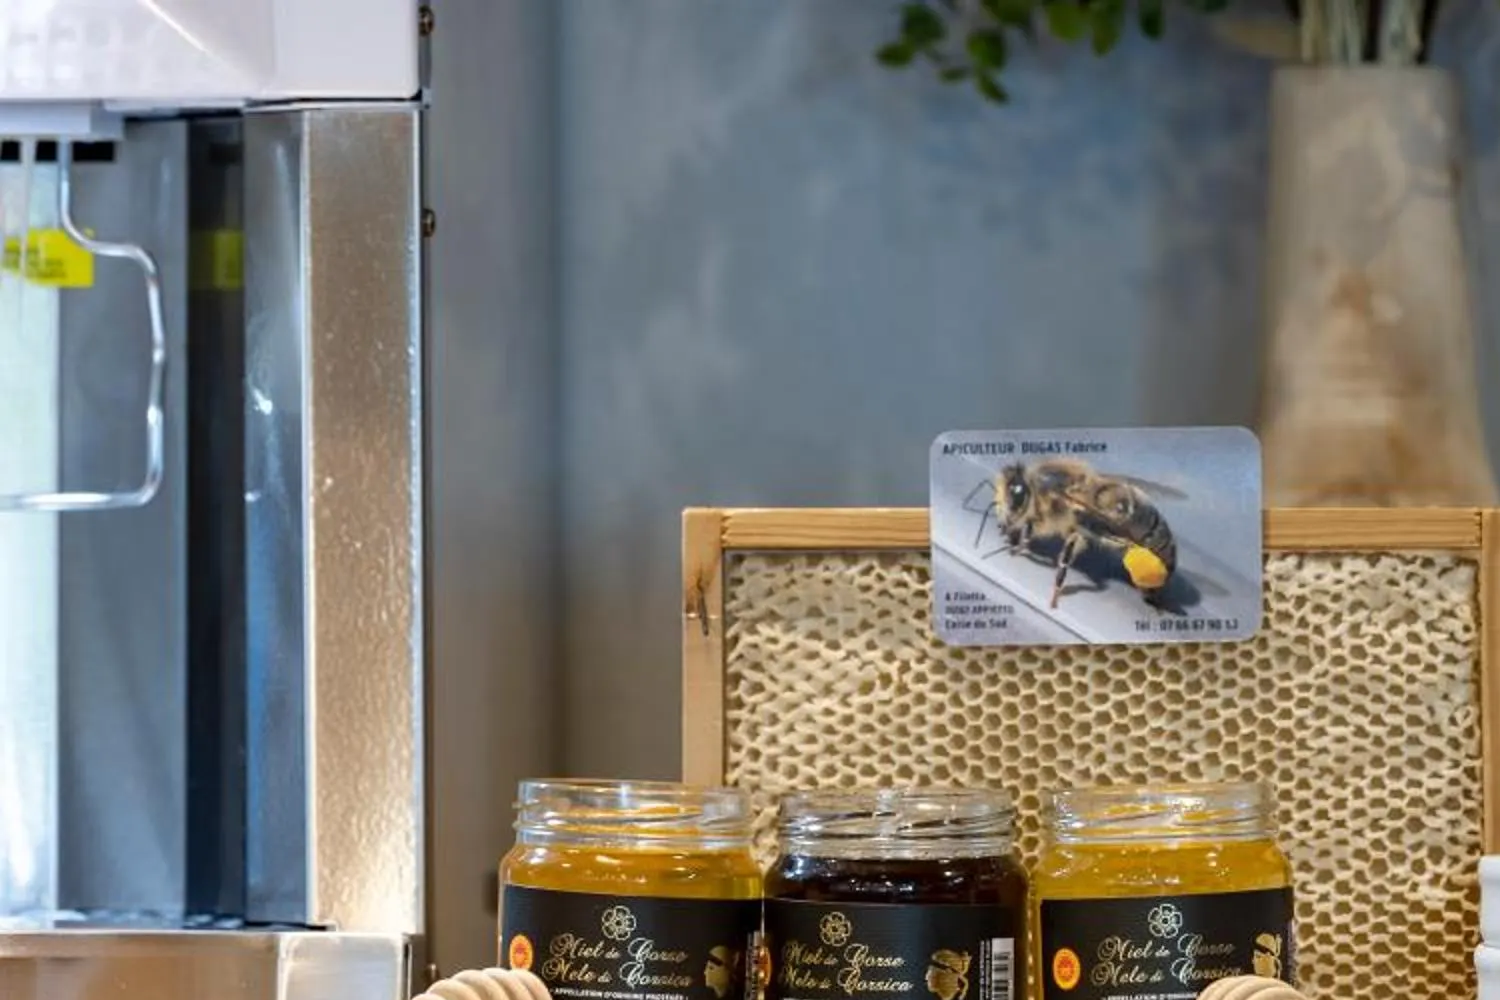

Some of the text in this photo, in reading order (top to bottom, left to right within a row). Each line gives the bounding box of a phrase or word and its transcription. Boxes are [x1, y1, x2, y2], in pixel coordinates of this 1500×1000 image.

[1021, 441, 1062, 454] DUGAS
[1065, 440, 1108, 453] Fabrice
[550, 933, 604, 960] Miel
[628, 937, 688, 964] Corse
[844, 943, 905, 968] Corse
[1097, 935, 1152, 963] Miel
[837, 967, 914, 996] Corsica
